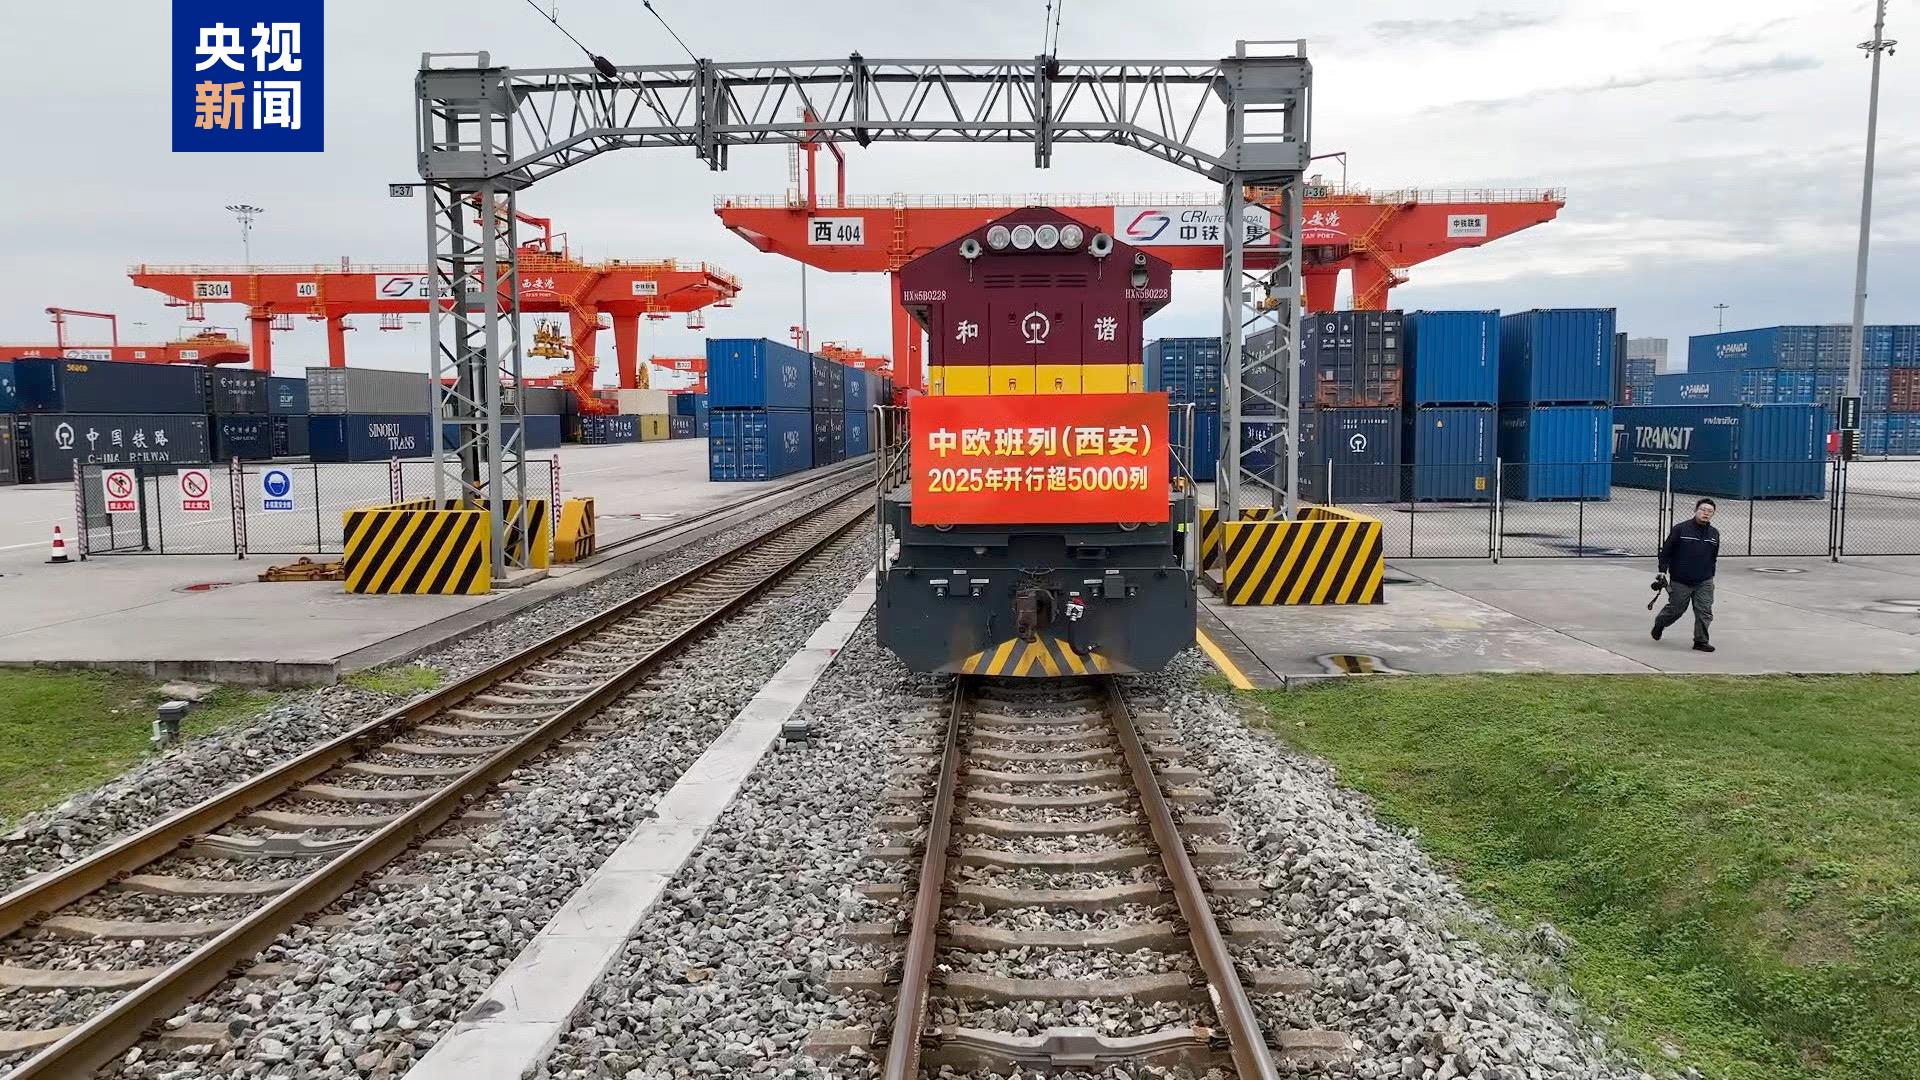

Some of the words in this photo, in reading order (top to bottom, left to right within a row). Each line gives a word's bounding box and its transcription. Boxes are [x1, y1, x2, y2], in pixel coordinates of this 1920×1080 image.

[1302, 210, 1340, 227] 安港
[1180, 225, 1264, 241] 中铁集
[956, 319, 979, 344] 和
[1094, 317, 1118, 342] 谐
[86, 427, 169, 450] 中国铁路
[368, 423, 400, 438] SINORU
[928, 424, 1151, 457] 中欧班列(西安)
[1635, 426, 1695, 450] TRANSIT
[388, 436, 415, 450] TRANS
[928, 465, 1148, 493] 2025年开行超5000列
